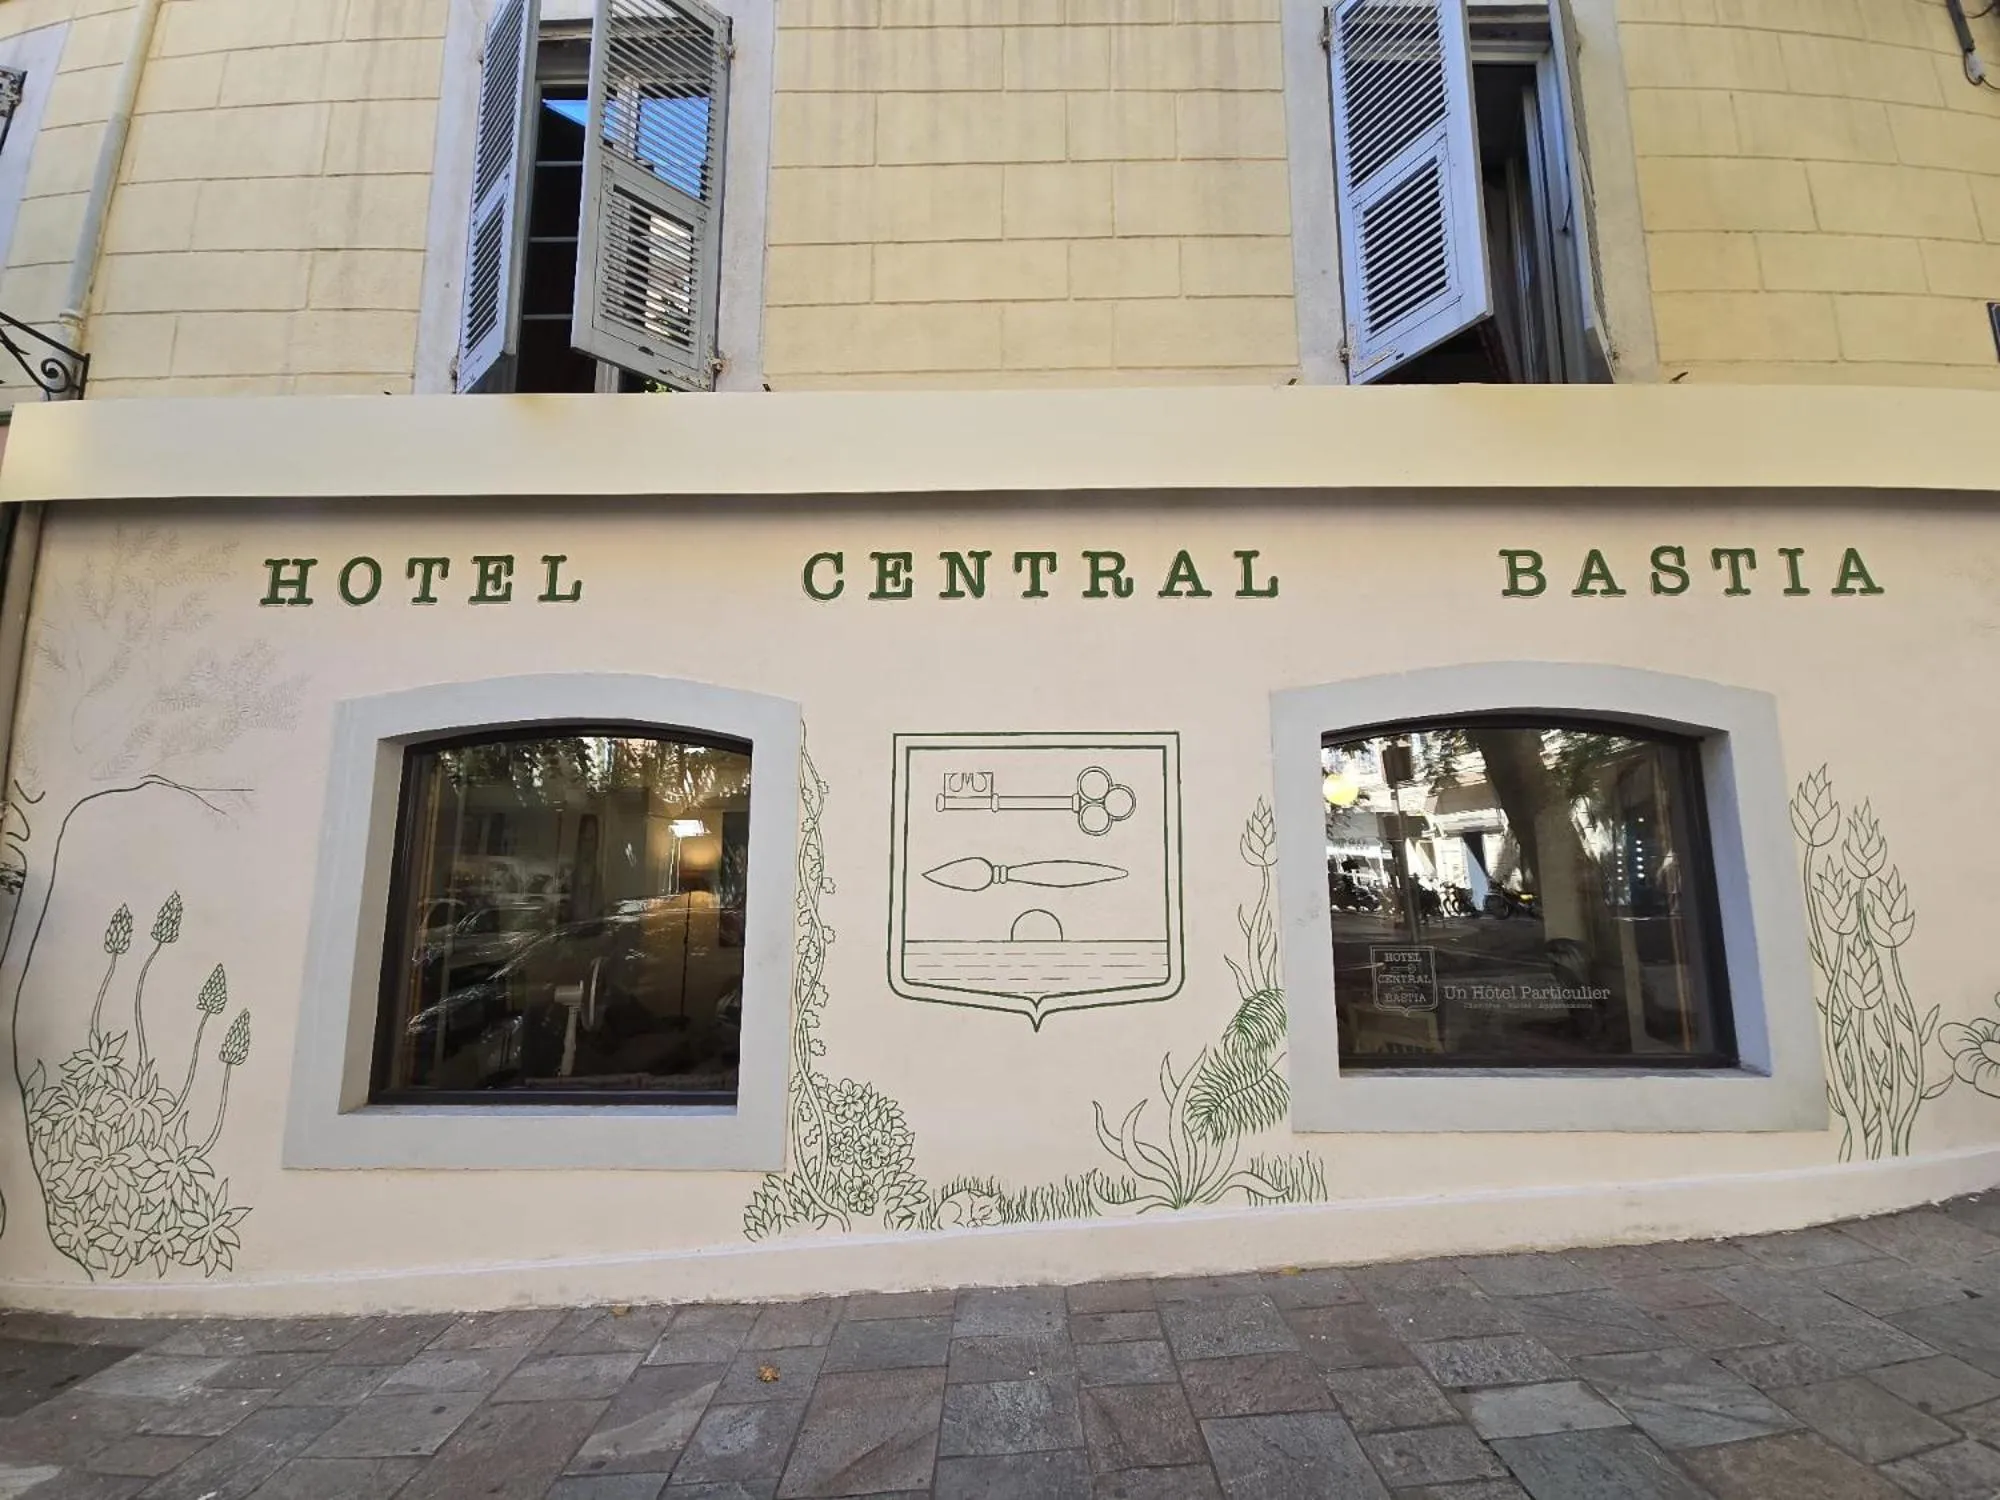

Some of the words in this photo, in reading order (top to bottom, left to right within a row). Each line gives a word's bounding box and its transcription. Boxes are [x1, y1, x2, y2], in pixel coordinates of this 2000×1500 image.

[259, 554, 583, 607] HOTEL
[802, 549, 1279, 601] CENTRAL
[1497, 545, 1885, 597] BASTIA
[1384, 952, 1421, 962] HOTEL
[1377, 974, 1431, 984] CENTRAL
[1443, 985, 1467, 1000] Un
[1519, 985, 1611, 1000] Particulier
